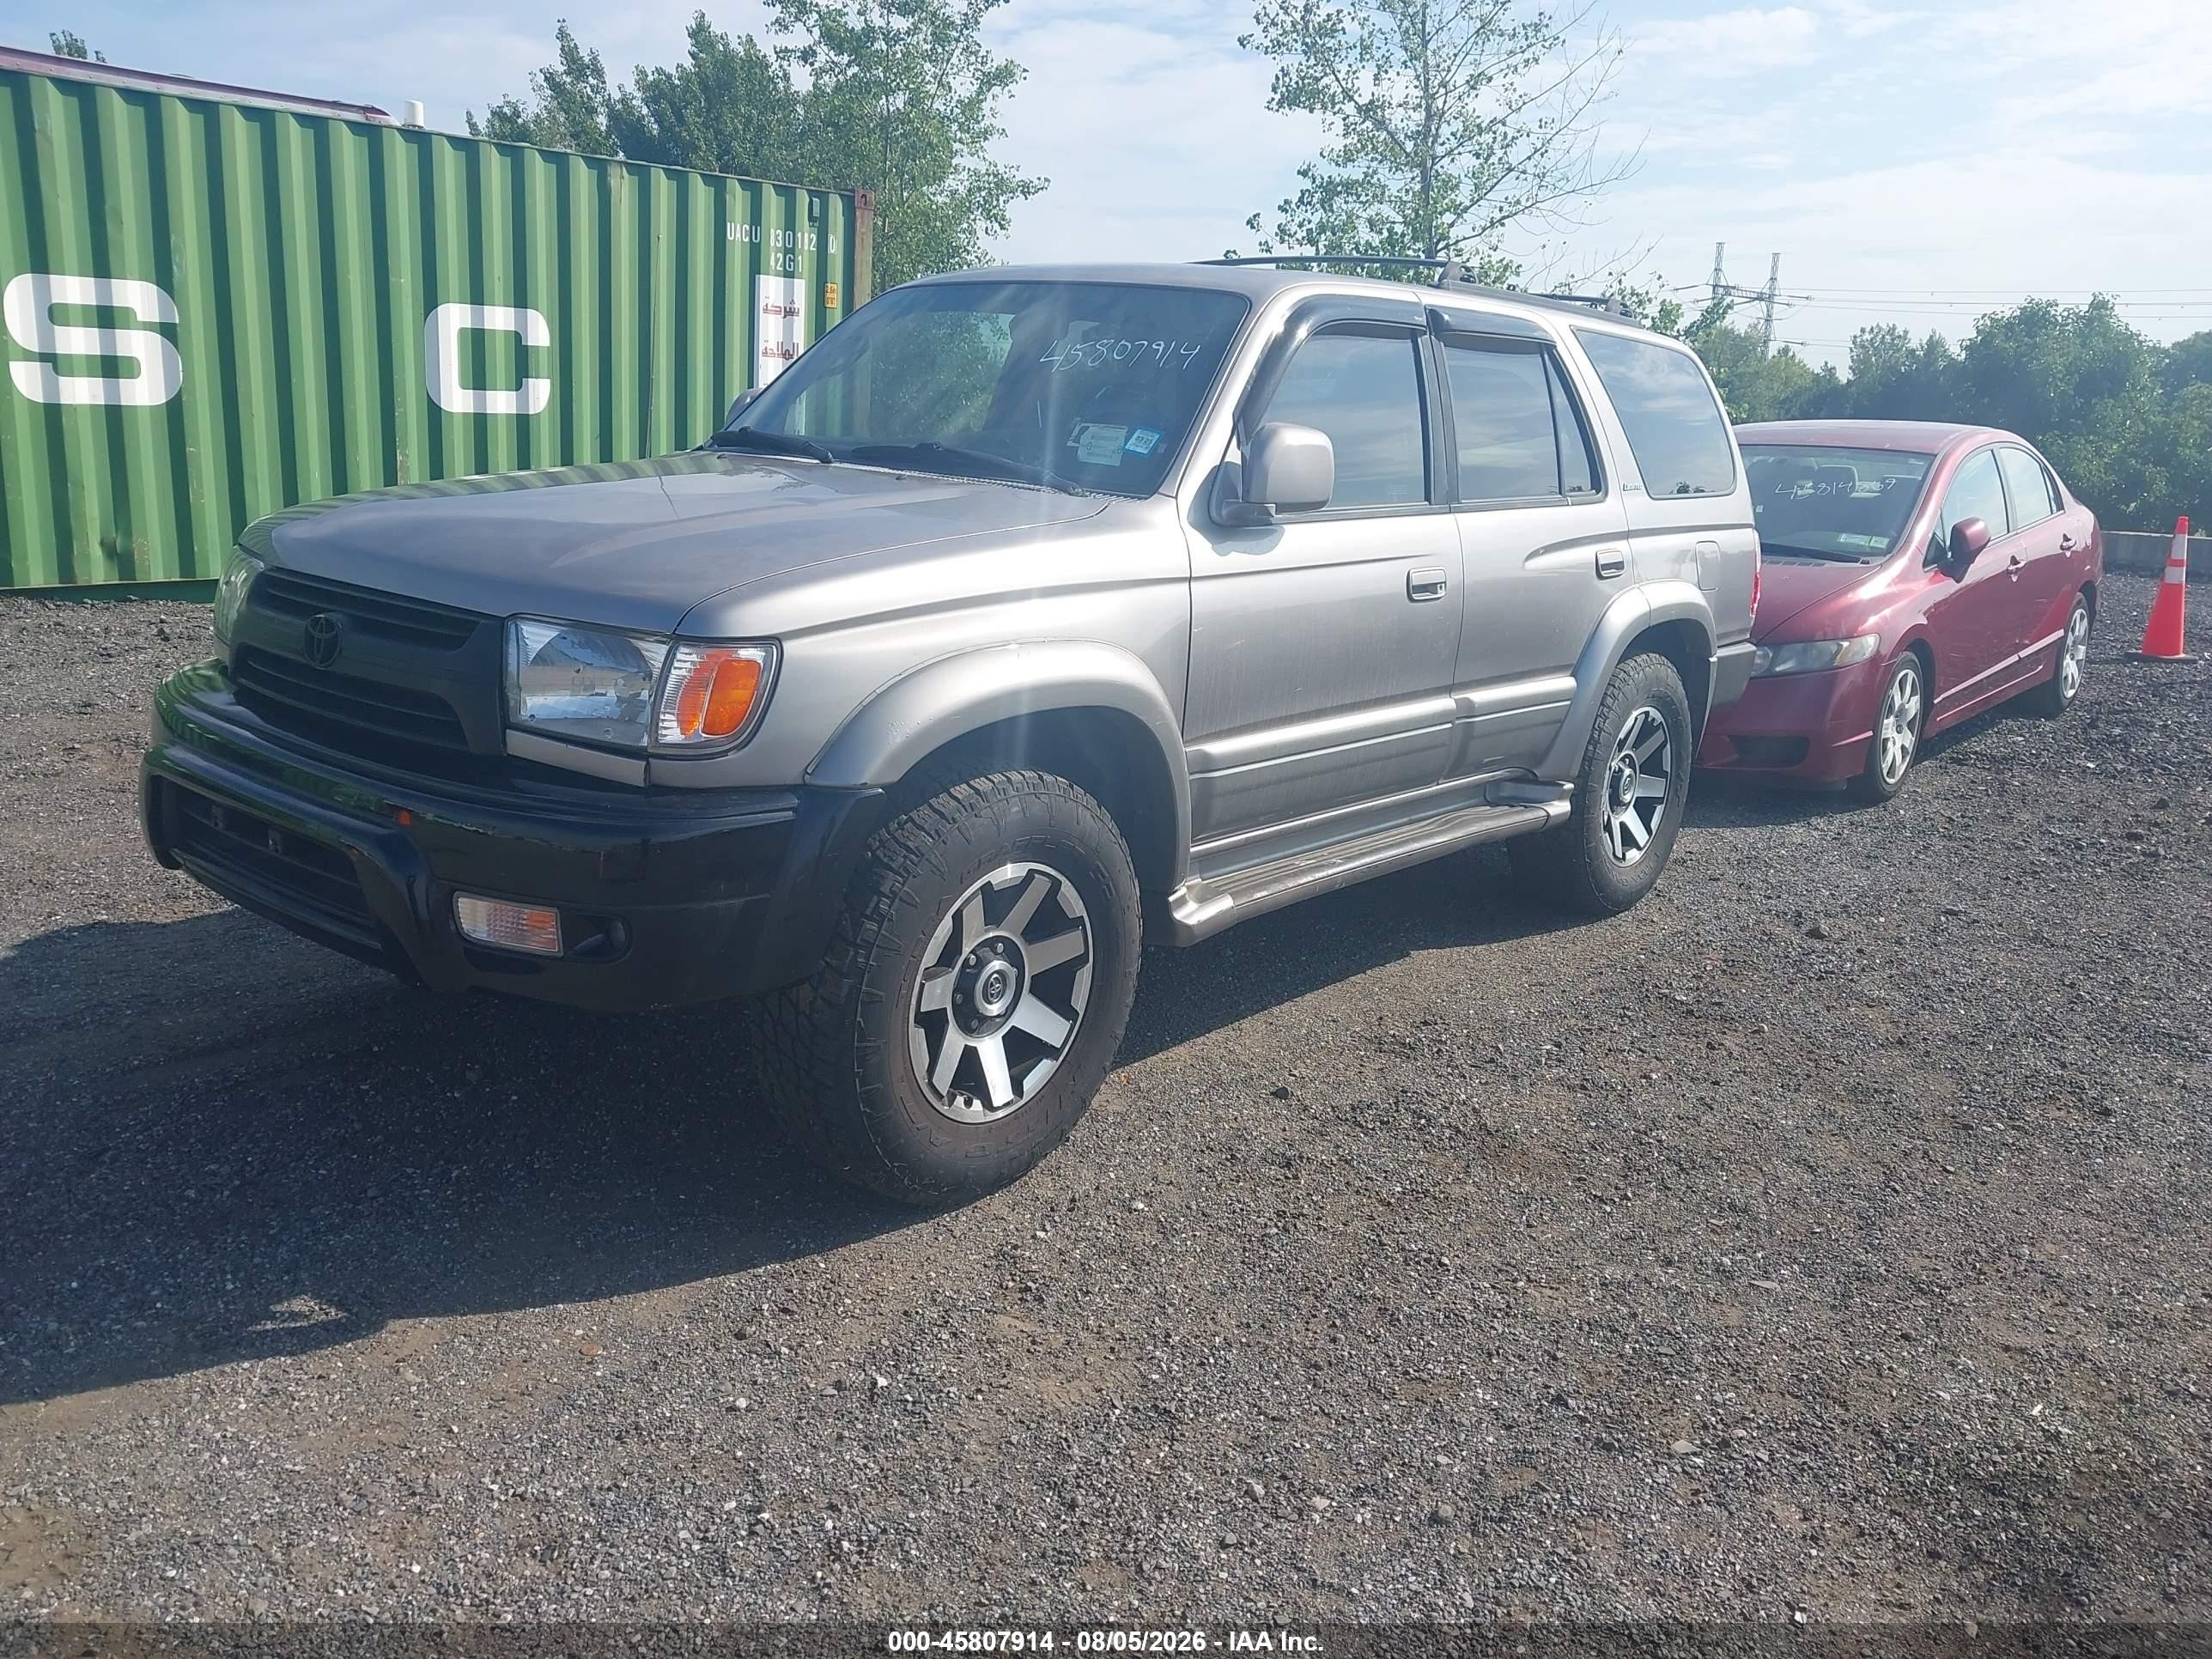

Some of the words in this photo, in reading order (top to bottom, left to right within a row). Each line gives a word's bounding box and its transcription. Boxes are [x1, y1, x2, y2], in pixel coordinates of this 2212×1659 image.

[726, 222, 761, 243] UACU
[769, 228, 817, 251] 830182
[769, 252, 803, 272] 42G1
[762, 295, 800, 319] شركة
[3, 273, 182, 406] S
[424, 302, 550, 415] C
[761, 339, 799, 361] الملاحة
[1038, 339, 1201, 373] 45807914
